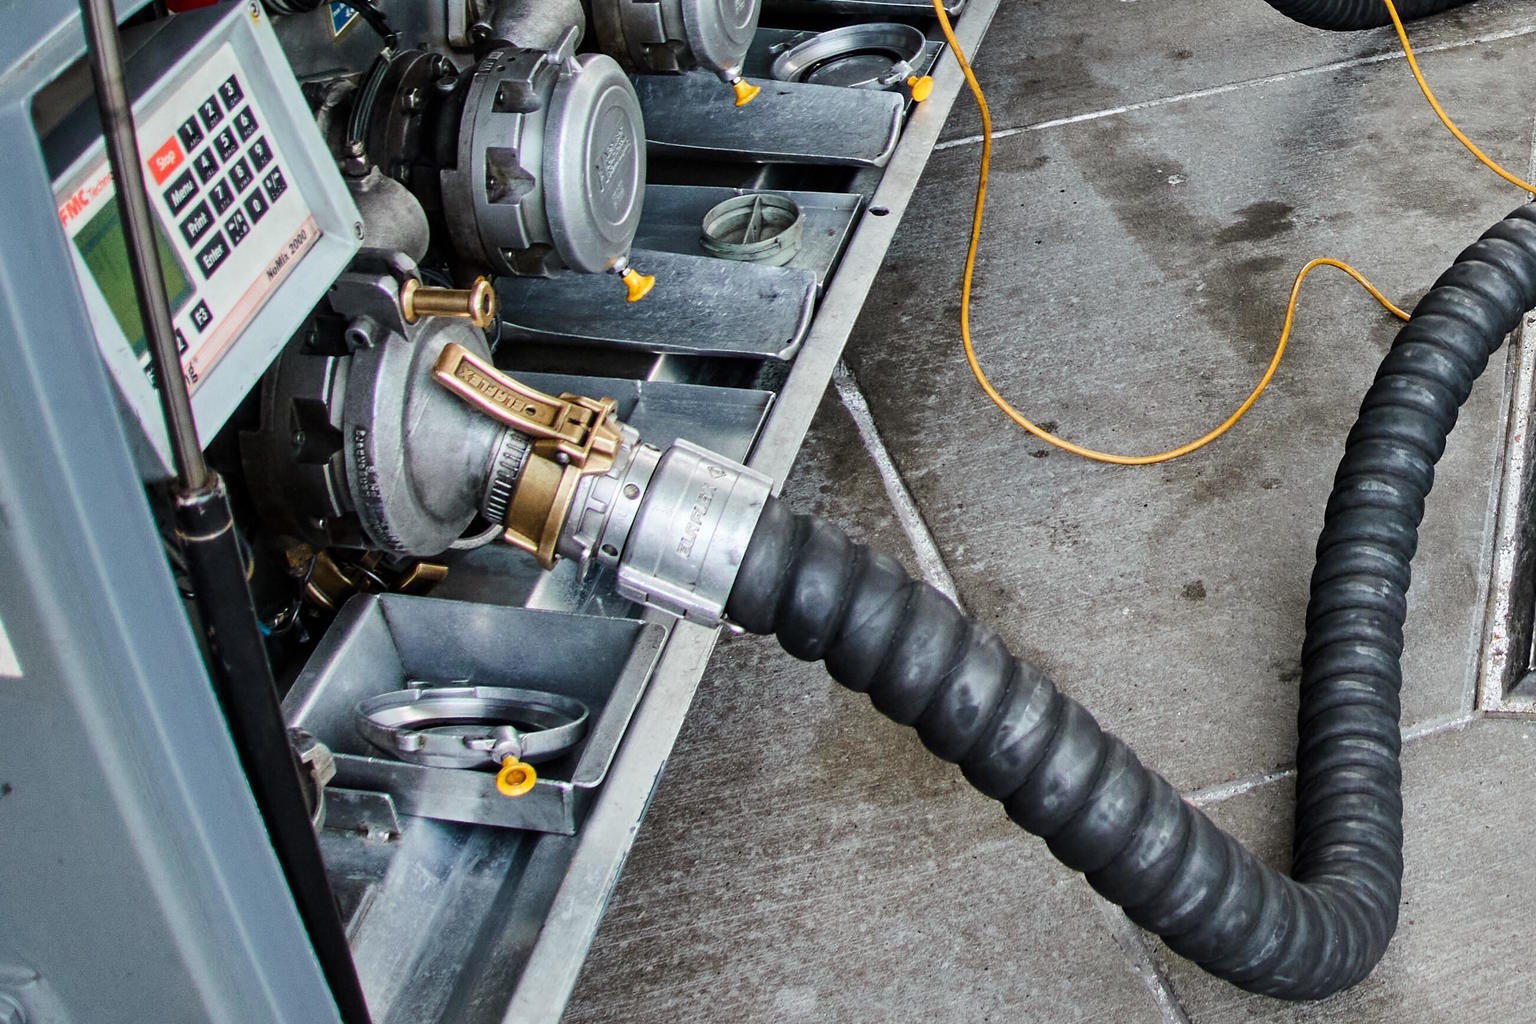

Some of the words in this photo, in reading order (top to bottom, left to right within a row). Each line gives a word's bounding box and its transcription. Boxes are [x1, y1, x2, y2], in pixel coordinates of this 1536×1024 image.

[224, 81, 235, 96] 3
[204, 102, 216, 118] 2
[240, 112, 250, 128] 6
[184, 122, 195, 136] 1
[220, 132, 231, 148] 5
[254, 142, 264, 157] 9
[155, 149, 177, 172] Stop
[201, 153, 211, 169] 4
[170, 179, 195, 209] Menu
[213, 184, 224, 200] 7
[57, 186, 89, 227] FMC
[252, 198, 262, 213] 0
[186, 211, 209, 238] Print
[202, 242, 225, 271] Enter
[266, 252, 290, 282] NoMix
[288, 228, 308, 255] 2000
[458, 366, 529, 412] ELAFLEX
[676, 482, 718, 560] ELAFLEX
